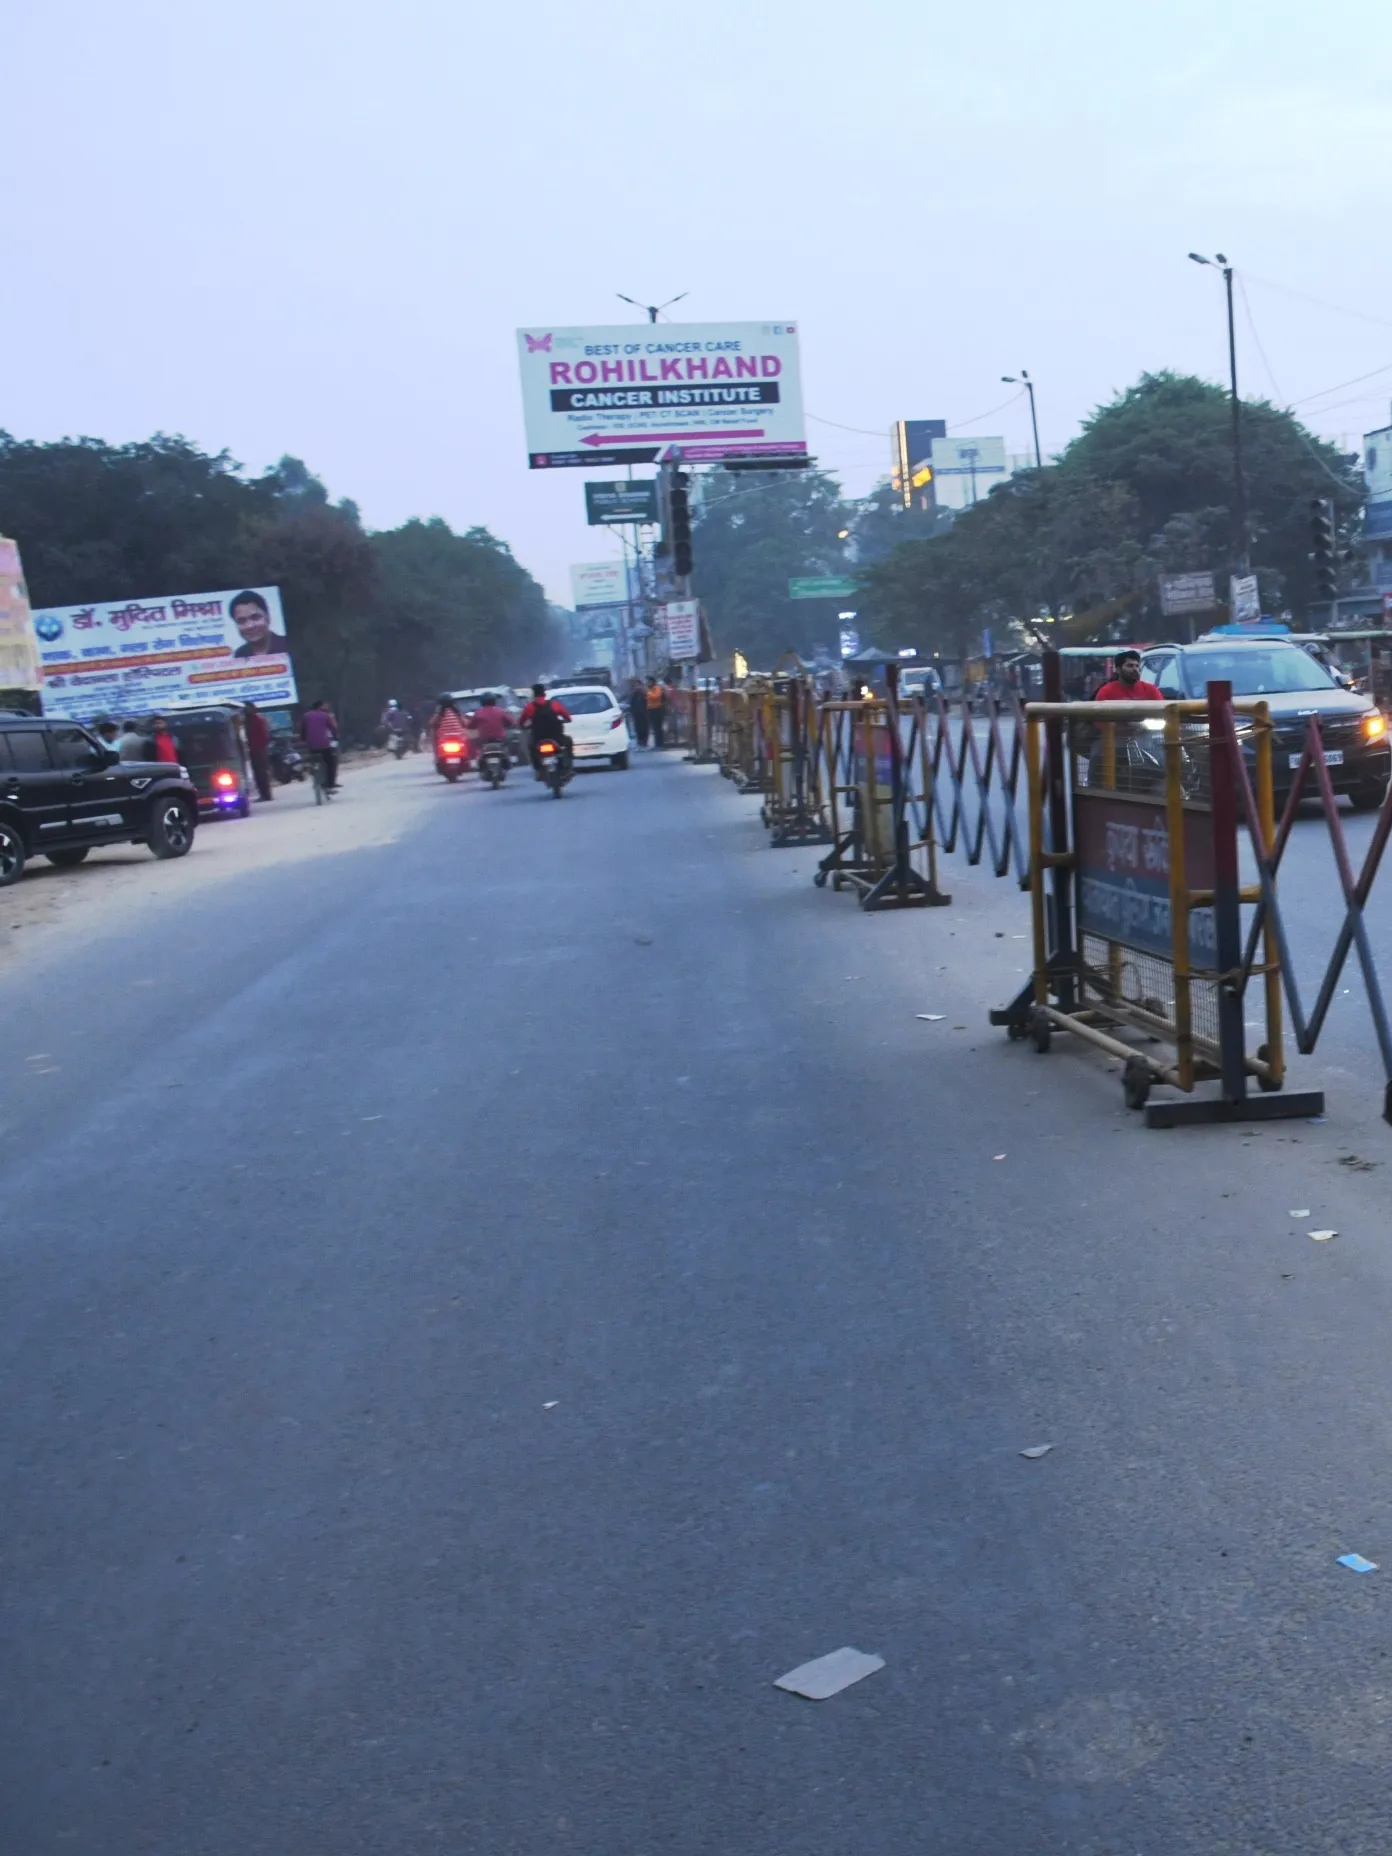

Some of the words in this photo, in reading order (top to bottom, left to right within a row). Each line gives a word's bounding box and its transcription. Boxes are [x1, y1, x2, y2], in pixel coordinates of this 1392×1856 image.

[585, 345, 619, 356] BEST
[623, 344, 642, 355] OF
[646, 342, 702, 354] CANCER
[707, 340, 742, 352] CARE
[549, 355, 783, 385] ROHILKHAND
[570, 390, 653, 408] CANCER
[657, 387, 761, 405] INSTITUTE
[70, 606, 103, 631] डॉ.
[108, 603, 166, 631] मुदित
[171, 599, 223, 620] मिश्रा
